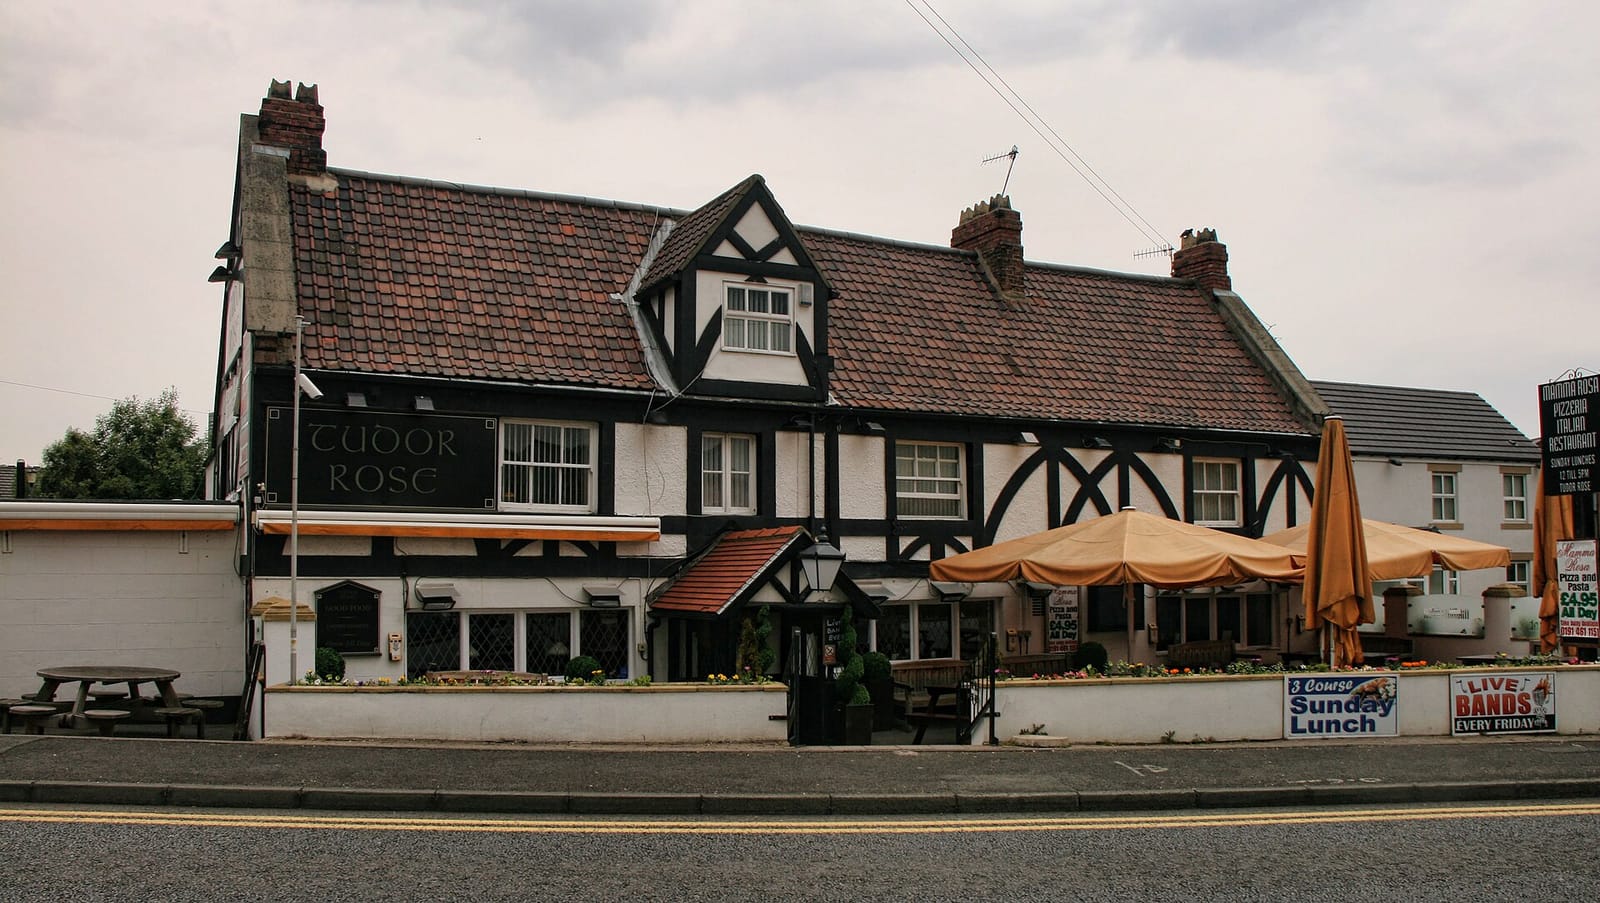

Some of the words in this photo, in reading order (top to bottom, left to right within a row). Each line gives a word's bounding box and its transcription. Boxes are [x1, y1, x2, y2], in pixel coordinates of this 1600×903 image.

[1542, 381, 1576, 401] MAMMA
[1577, 376, 1599, 396] ROSA
[1553, 398, 1588, 418] PIZZERIA
[1556, 416, 1586, 434] ITALIAN
[308, 423, 457, 456] TUDOR
[1549, 432, 1597, 453] RESTAURANT
[1550, 457, 1570, 468] SUNDAY
[1571, 454, 1596, 466] LUNCHES
[329, 463, 438, 494] ROSE
[1559, 470, 1566, 480] 12
[1558, 542, 1595, 557] Mamma
[1565, 558, 1590, 572] Rosa
[1560, 574, 1580, 582] Pizza
[1581, 573, 1597, 582] and
[1567, 582, 1590, 591] Pasta
[1560, 592, 1598, 606] £4.95
[1561, 607, 1575, 618] All
[1578, 607, 1598, 620] Day
[1050, 620, 1077, 630] £4.95
[1062, 630, 1077, 640] Day
[1291, 680, 1300, 693] 3
[1304, 679, 1353, 692] Course
[1467, 677, 1519, 694] LIVE
[1290, 695, 1395, 717] Sunday
[1455, 692, 1532, 717] BANDS
[1290, 714, 1376, 734] Lunch
[1455, 719, 1492, 732] EVERY
[1494, 717, 1535, 730] FRIDAY
